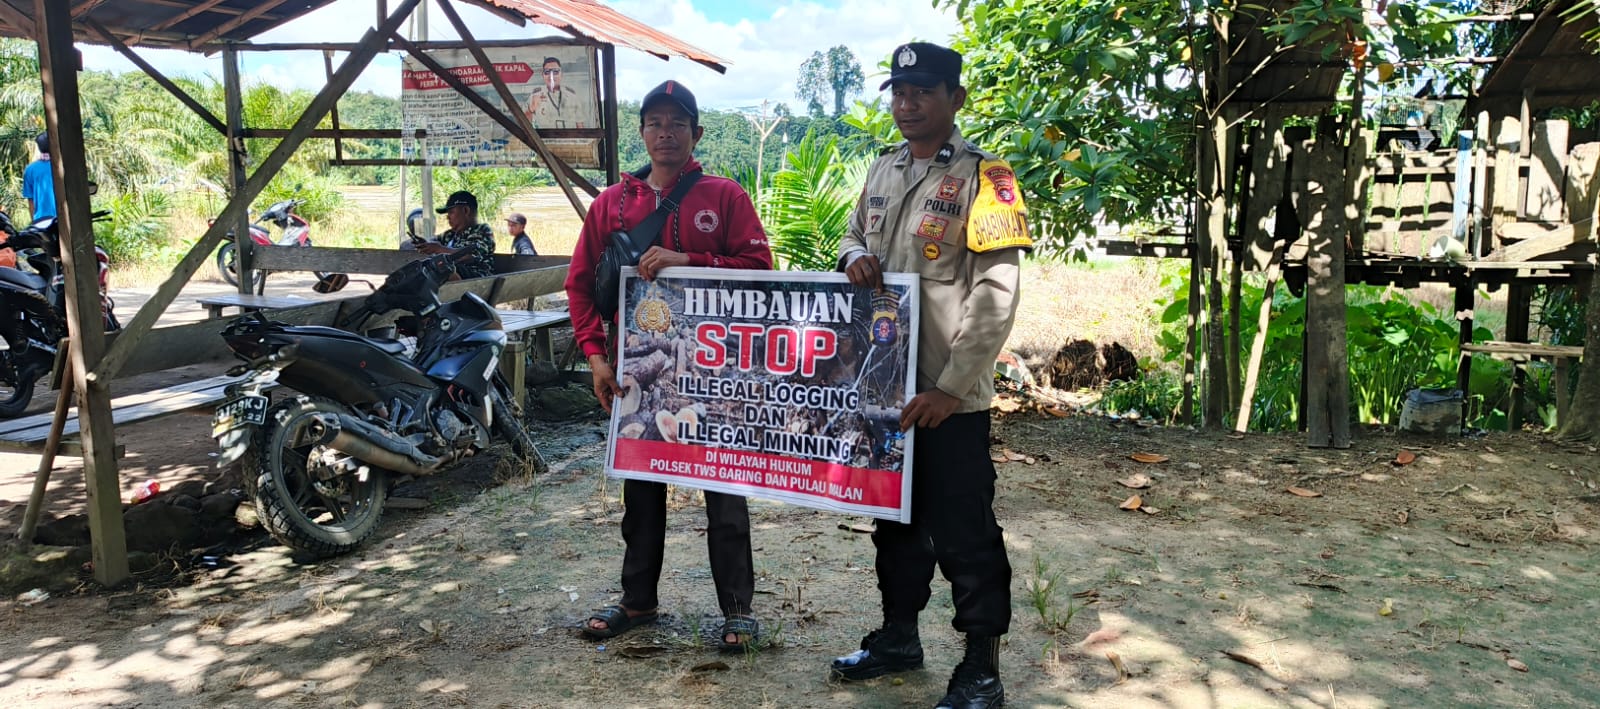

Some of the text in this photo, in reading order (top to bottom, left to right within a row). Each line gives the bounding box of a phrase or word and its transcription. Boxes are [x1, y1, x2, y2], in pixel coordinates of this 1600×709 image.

[924, 199, 962, 215] POLRI
[683, 287, 854, 324] HIMBAUAN
[695, 322, 838, 377] STOP
[678, 376, 859, 411] ILLEGAL LOGGING
[745, 405, 786, 427] DAN
[677, 421, 850, 461] ILLEGAL MINNING
[650, 458, 692, 474] POLSEK
[694, 463, 717, 478] TWS
[719, 467, 762, 484] GARING
[764, 474, 788, 487] DAN
[790, 477, 826, 494] PULAU
[706, 450, 812, 476] DI WILAYAH HUKUM
